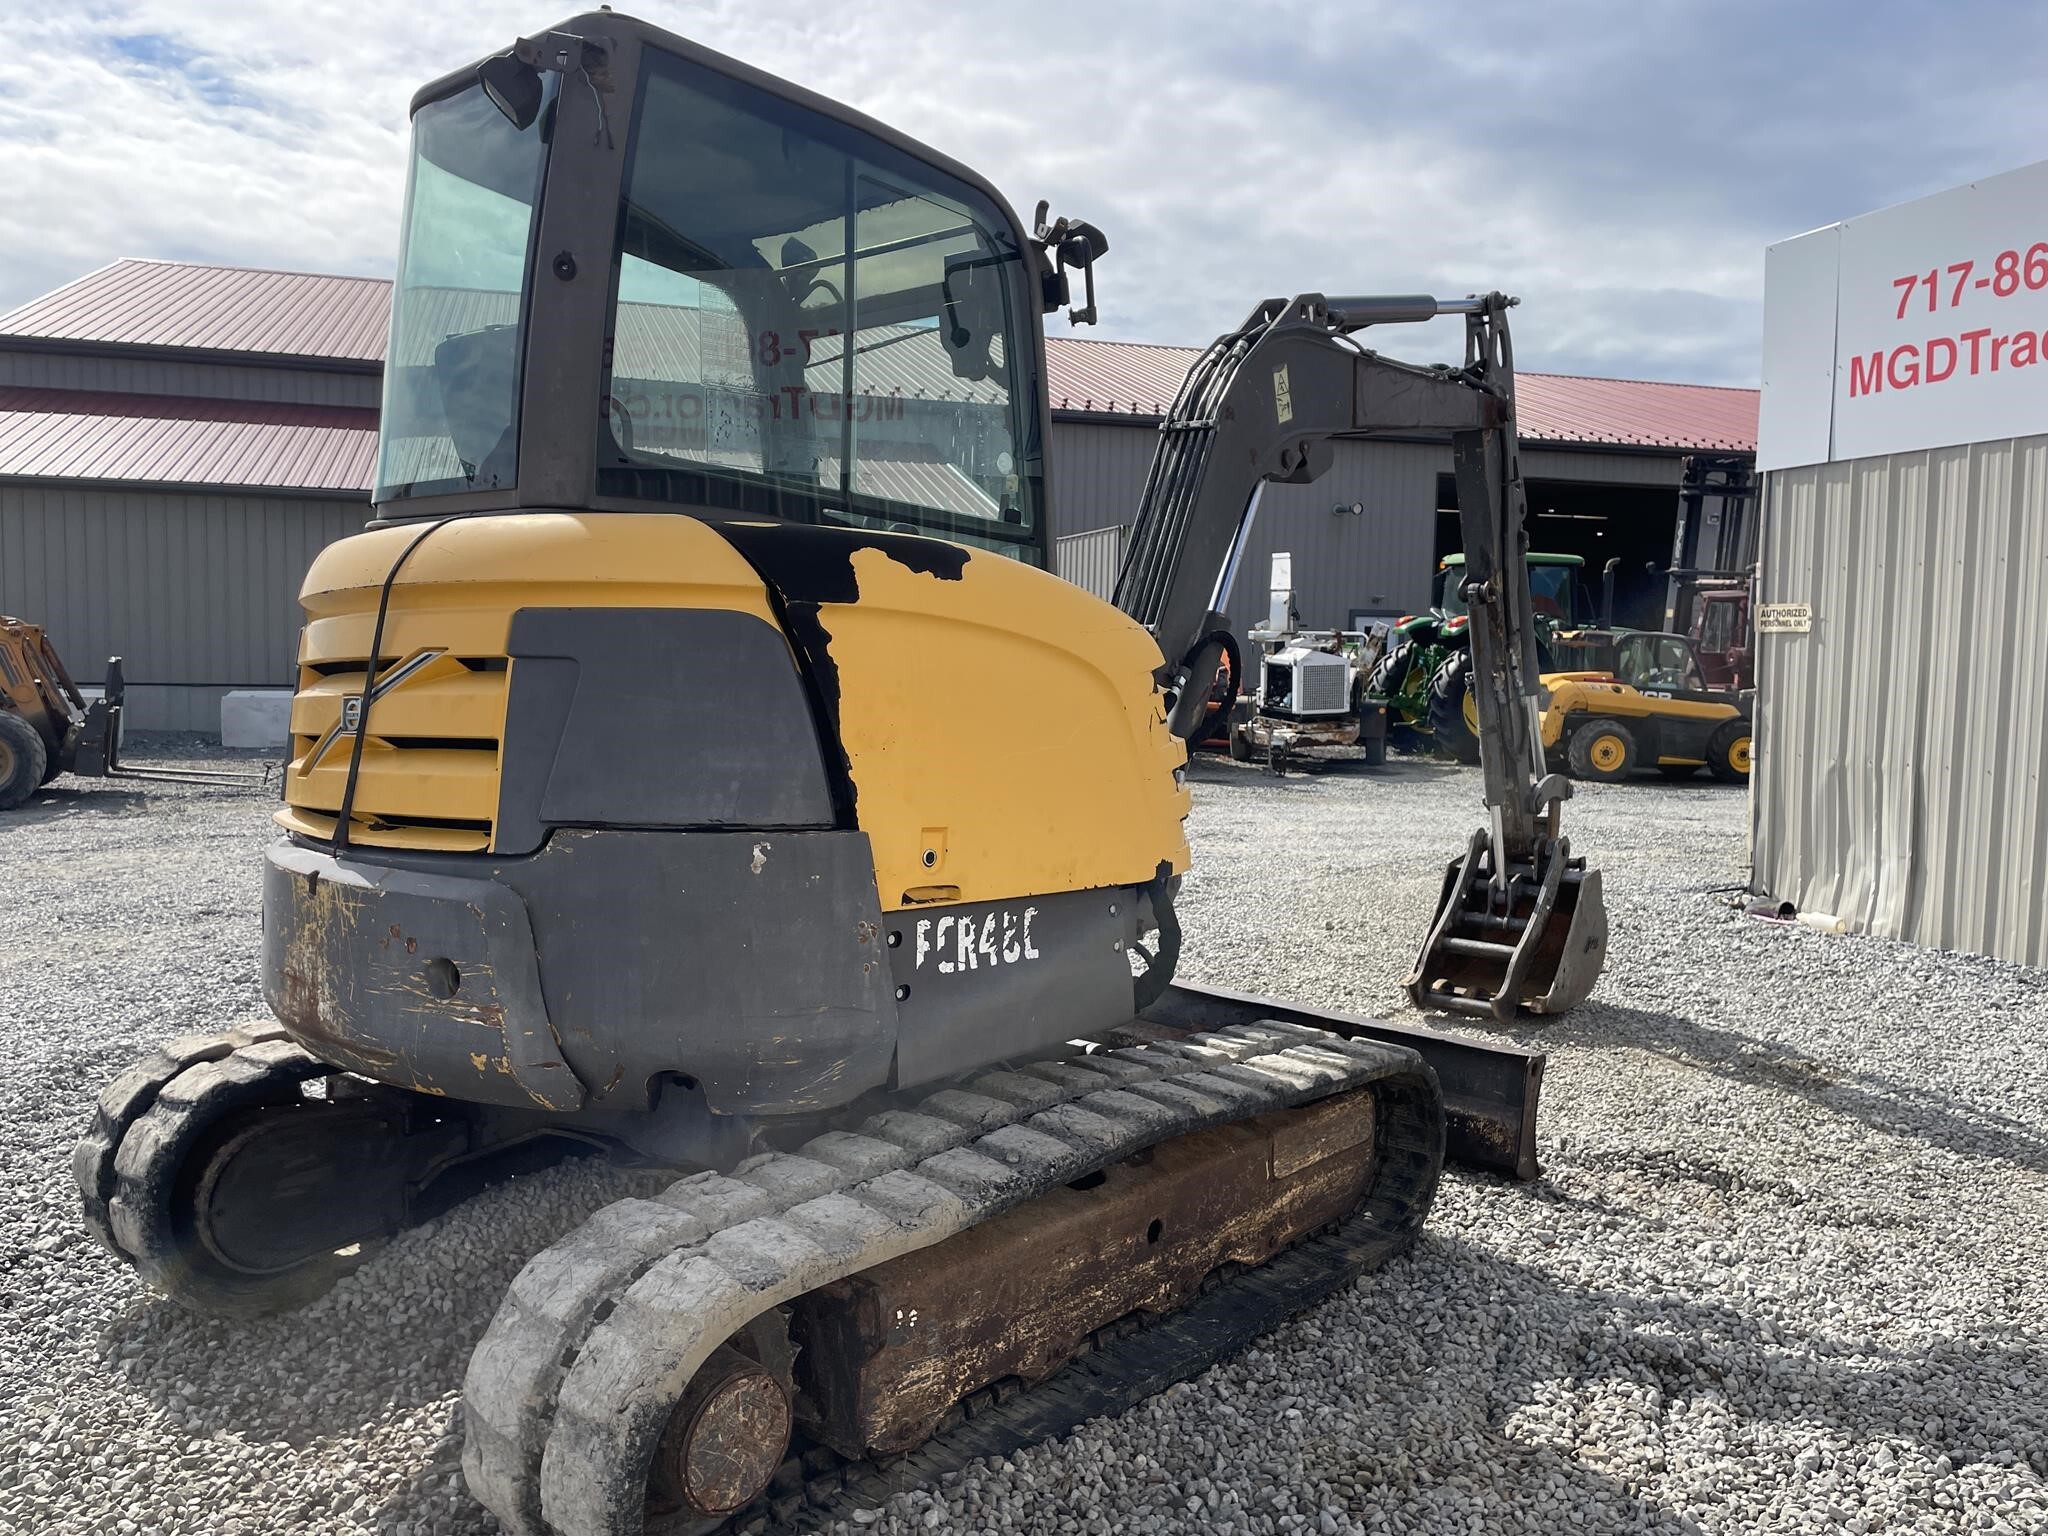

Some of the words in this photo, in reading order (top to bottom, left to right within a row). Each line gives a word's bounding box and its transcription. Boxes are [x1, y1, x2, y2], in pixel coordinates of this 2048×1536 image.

[1893, 242, 2048, 319] 717-86
[1850, 328, 2048, 398] MGDTra
[1760, 619, 1792, 627] PERSONNEL
[1761, 608, 1808, 618] AUTHORIZED
